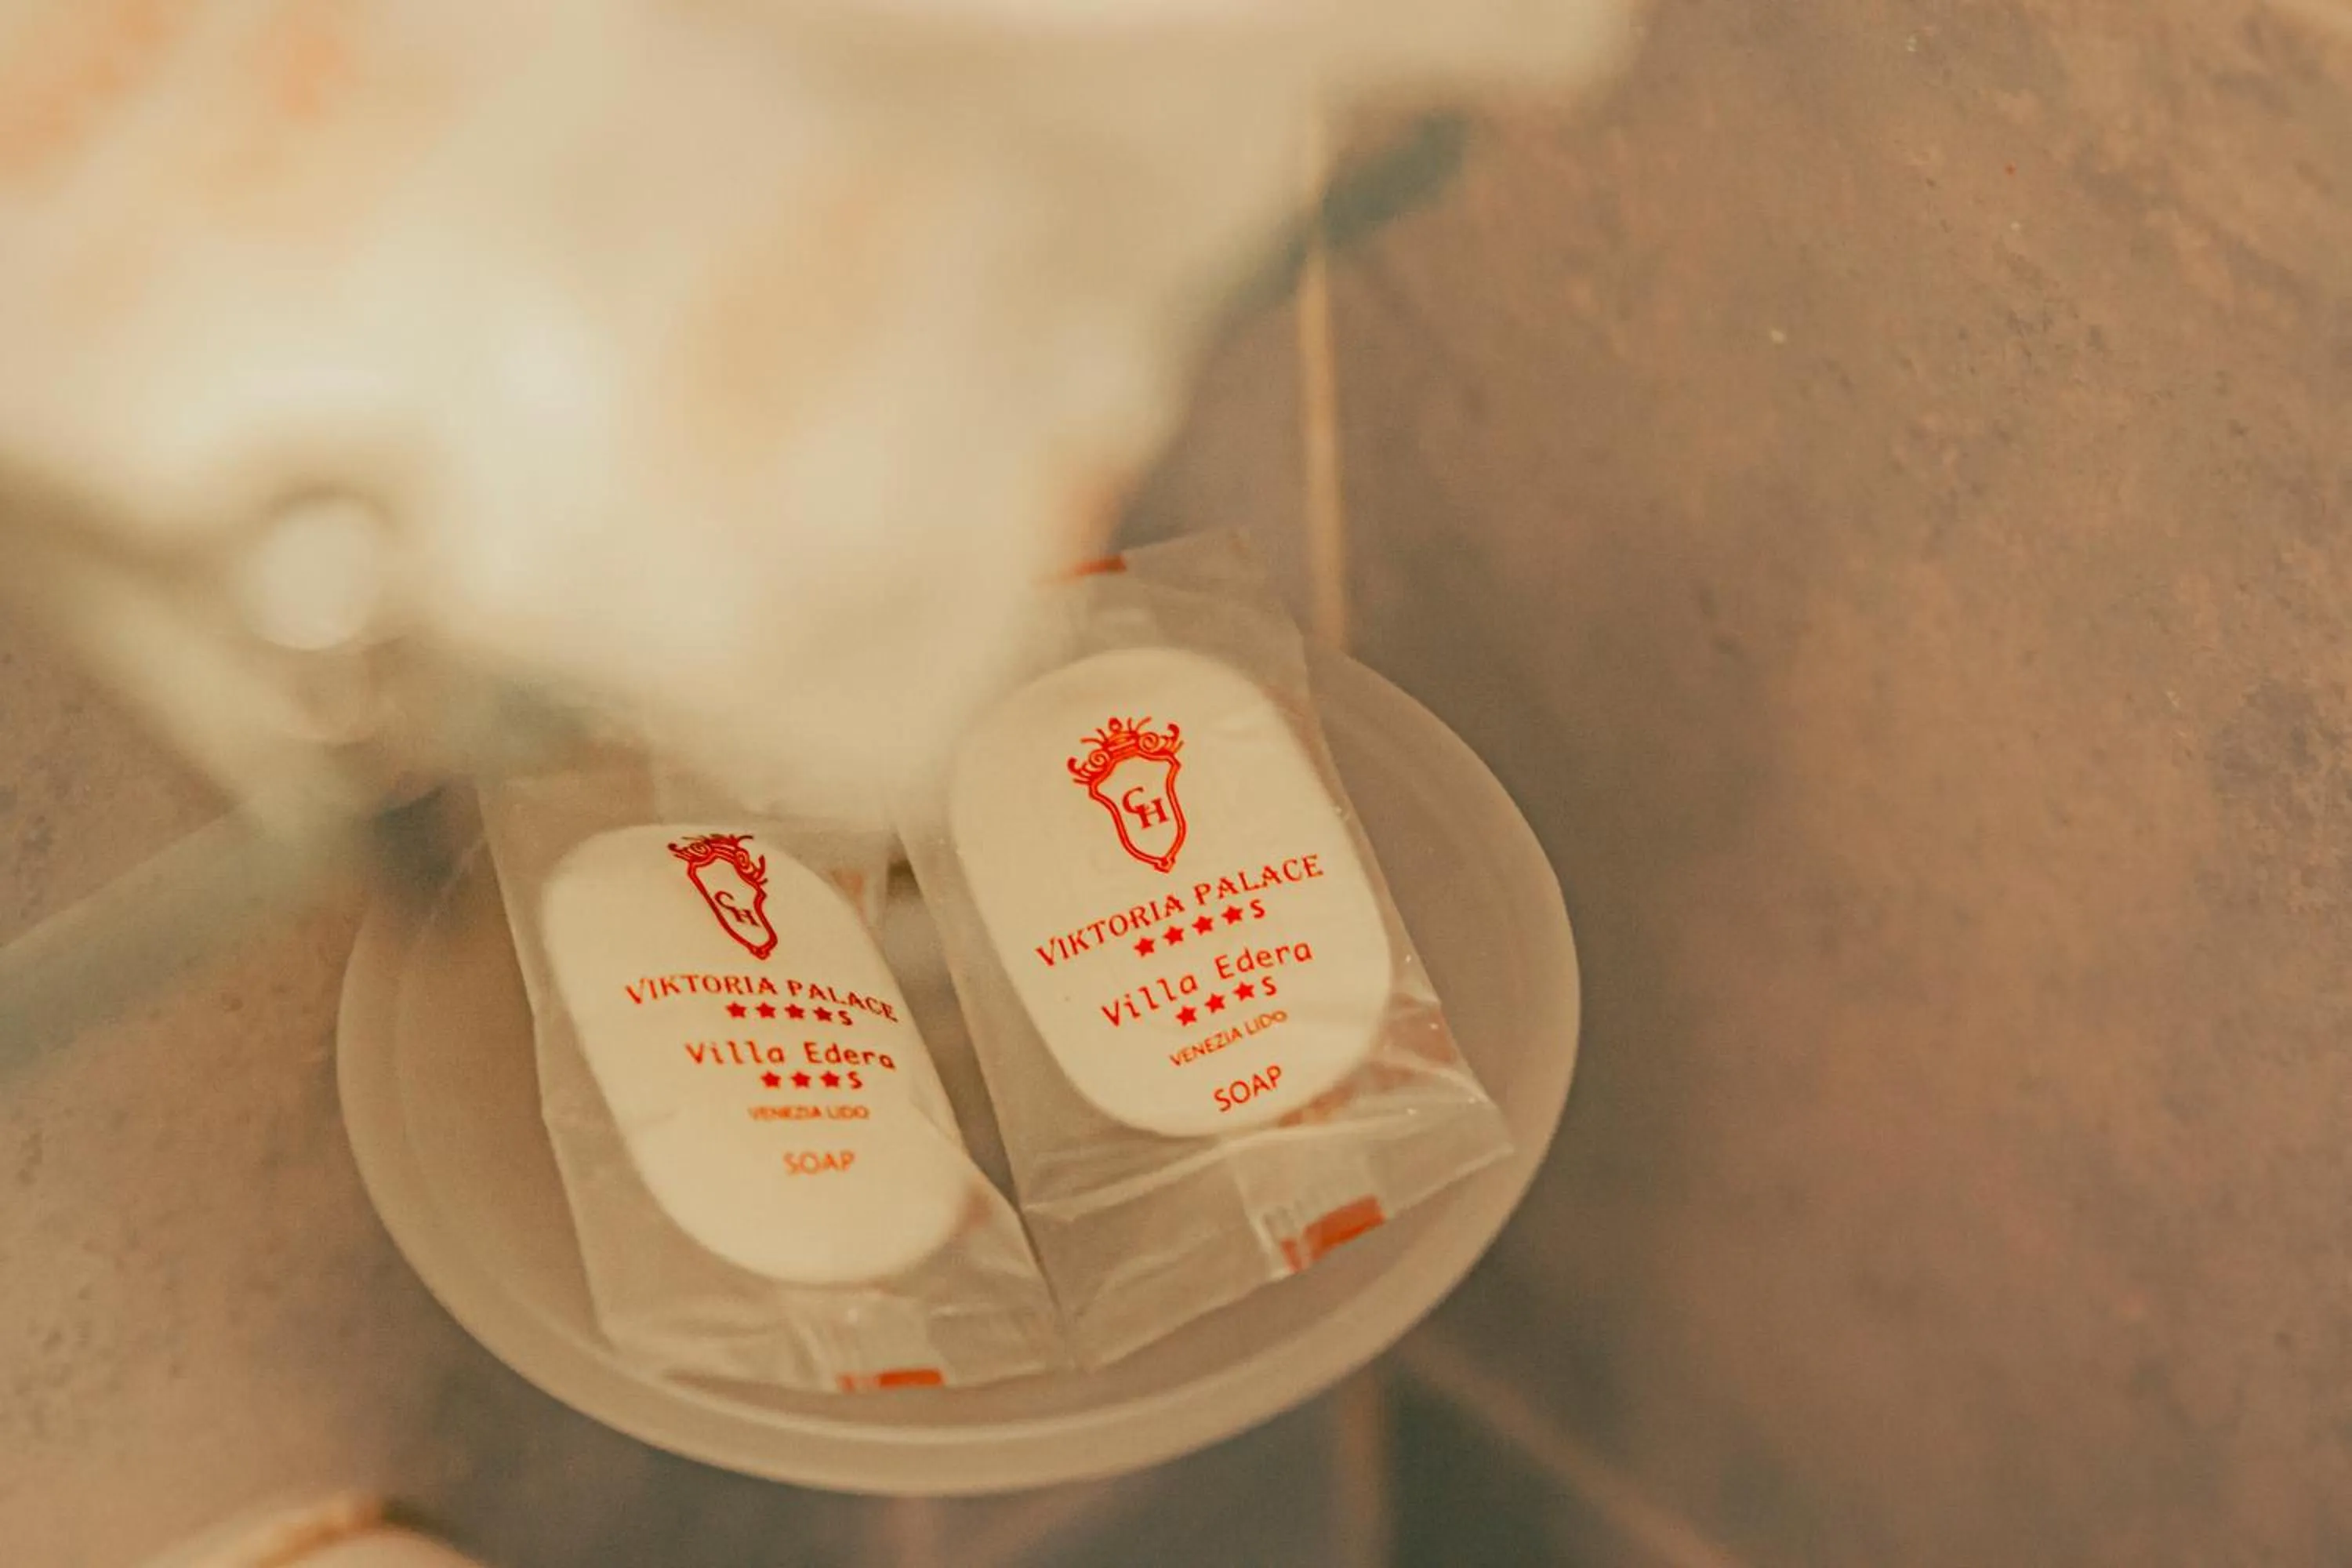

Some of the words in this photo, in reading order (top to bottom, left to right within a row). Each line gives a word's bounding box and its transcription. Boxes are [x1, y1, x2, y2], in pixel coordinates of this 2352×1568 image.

[1035, 894, 1185, 967] VIKTORIA
[1193, 855, 1323, 906] PALACE
[1250, 899, 1265, 919] S
[626, 974, 778, 1005] VIKTORIA
[787, 979, 898, 1023] PALACE
[1101, 974, 1199, 1027] Villa
[1214, 941, 1313, 980] Edera
[1261, 976, 1278, 996] S
[838, 1010, 854, 1026] S
[1169, 1025, 1243, 1067] VENEZIA
[1244, 1009, 1288, 1036] LIDO
[685, 1040, 786, 1065] Villa
[804, 1041, 897, 1071] Edera
[848, 1070, 863, 1090] S
[1213, 1065, 1283, 1112] SOAP
[783, 1150, 855, 1175] SOAP
